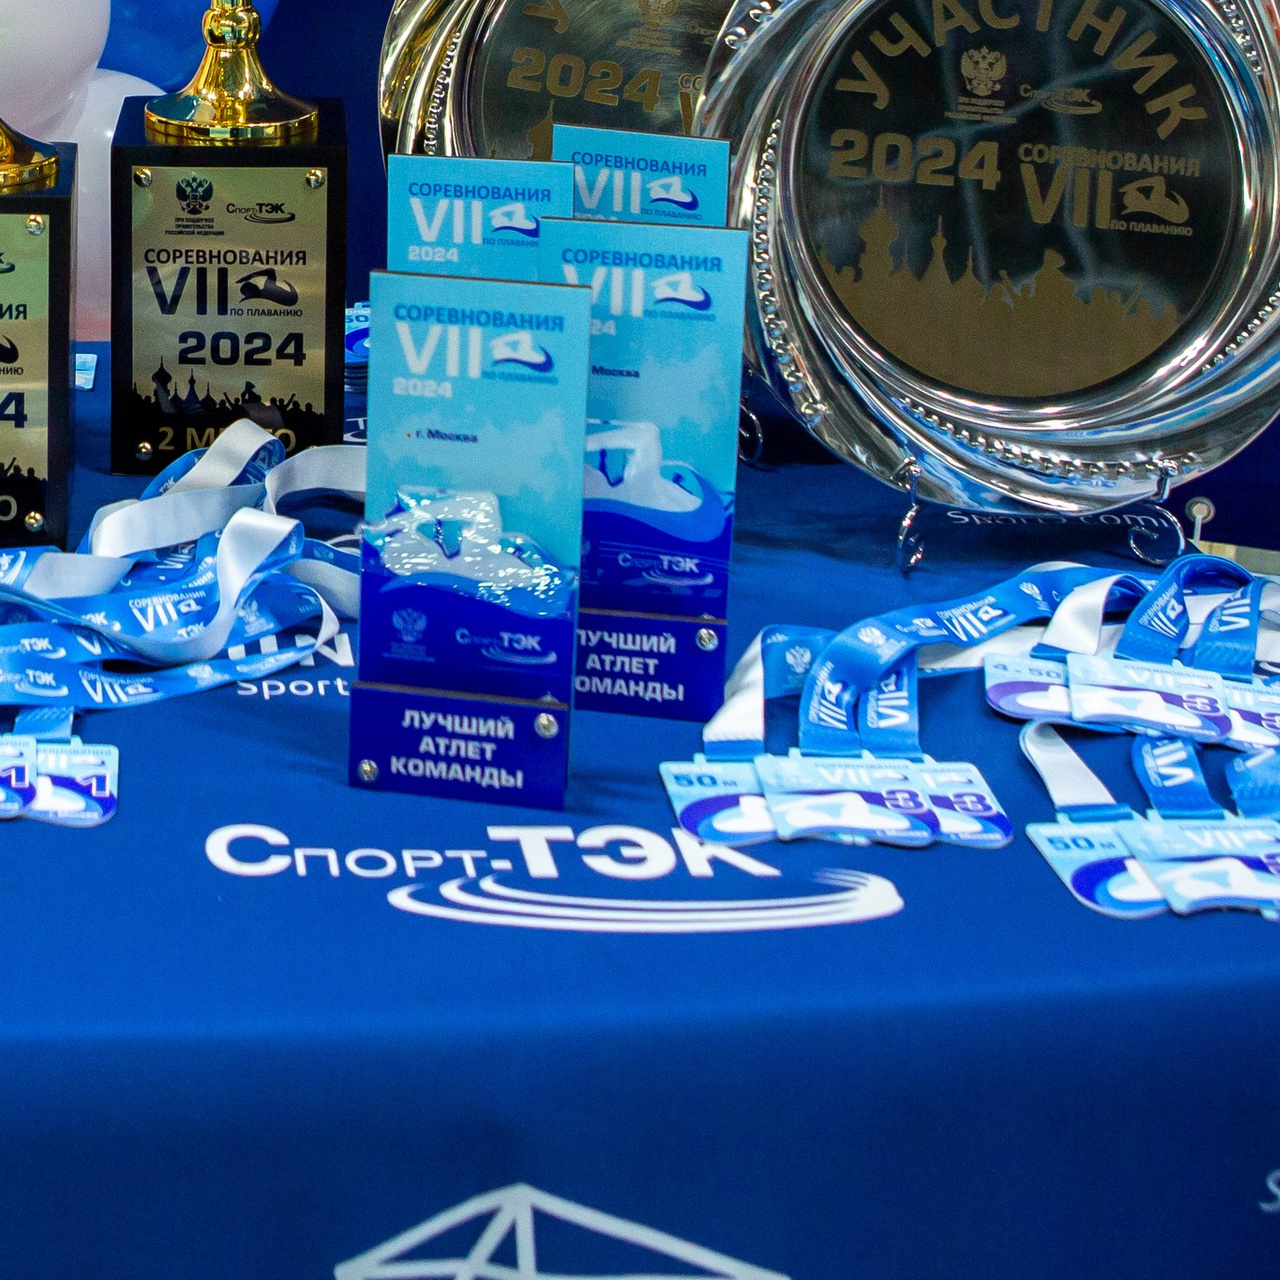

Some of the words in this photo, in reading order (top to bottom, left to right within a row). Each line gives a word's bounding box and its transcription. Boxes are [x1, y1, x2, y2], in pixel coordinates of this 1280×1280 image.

[507, 46, 661, 112] 2024
[571, 151, 707, 177] СОРЕВНОВАНИЯ
[828, 128, 1001, 191] 2024
[1019, 143, 1201, 178] СОРЕВНОВАНИЯ
[408, 182, 551, 202] СОРЕВНОВАНИЯ
[574, 166, 641, 214] VII
[1020, 163, 1113, 229] VII
[409, 197, 483, 244] VII
[1109, 219, 1127, 231] ПО
[1130, 221, 1193, 236] ПЛАВАНИЮ
[408, 245, 459, 263] 2024
[497, 238, 538, 247] ПЛАВАНИ
[144, 248, 307, 266] СОРЕВНОВАНИЯ
[562, 248, 722, 272] СОРЕВНОВАНИЯ
[146, 266, 229, 316] VII
[230, 308, 244, 317] ПО
[246, 308, 303, 318] ПЛАВАНИЮ
[393, 304, 564, 332] СОРЕВНОВАНИЯ
[591, 321, 616, 336] 24
[178, 331, 307, 367] 2024
[396, 322, 482, 378] VII
[591, 365, 640, 379] Москва
[393, 378, 453, 398] 2024
[158, 427, 175, 450] 2
[428, 430, 478, 444] Москва
[128, 590, 207, 609] СОРЕВНОВАНИЯ
[937, 595, 997, 619] СОРЕВНОВАНИЯ
[131, 601, 179, 632] VII
[943, 611, 988, 642] VII
[1219, 598, 1251, 632] VII
[586, 654, 658, 675] АТЛЕТ
[992, 663, 1008, 672] 4
[1028, 667, 1062, 679] 50
[236, 677, 351, 700] Sport
[574, 675, 685, 702] ОМАНДЫ
[1125, 668, 1176, 687] VII
[81, 678, 129, 703] VII
[877, 691, 909, 728] VII
[1180, 693, 1221, 715] 3
[402, 709, 514, 739] ЛУЧШИЙ
[419, 737, 496, 761] АТЛЕТ
[75, 772, 110, 797] 1
[391, 756, 523, 790] КОМАНДЫ
[673, 773, 718, 788] 50
[818, 764, 872, 785] VII
[883, 789, 923, 815] 3
[951, 792, 998, 817] 3
[1046, 836, 1095, 851] 50
[1184, 829, 1245, 850] VII
